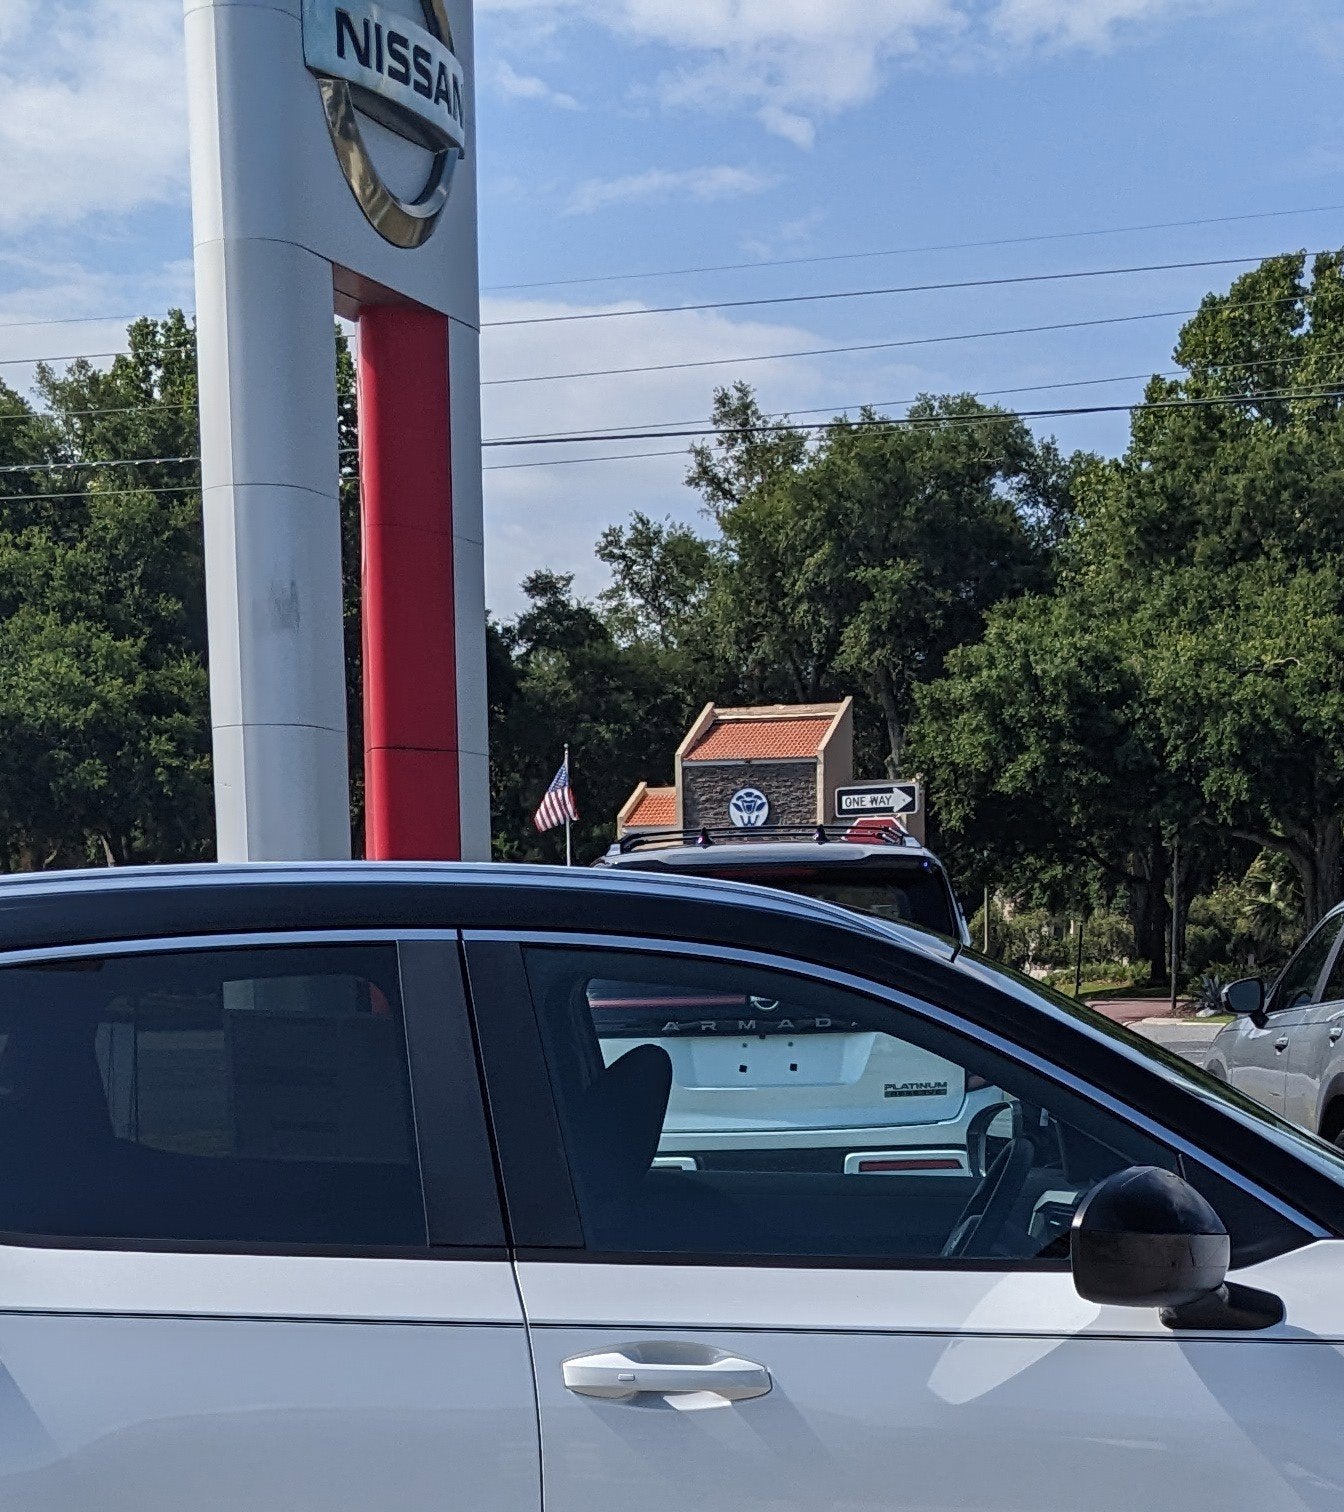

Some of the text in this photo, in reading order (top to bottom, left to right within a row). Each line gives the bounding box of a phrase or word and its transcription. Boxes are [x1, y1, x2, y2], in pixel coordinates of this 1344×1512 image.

[335, 7, 465, 130] NISSAN
[844, 794, 892, 808] ONE WAY
[661, 1017, 858, 1032] ARMAD
[884, 1081, 948, 1091] PLATINUM
